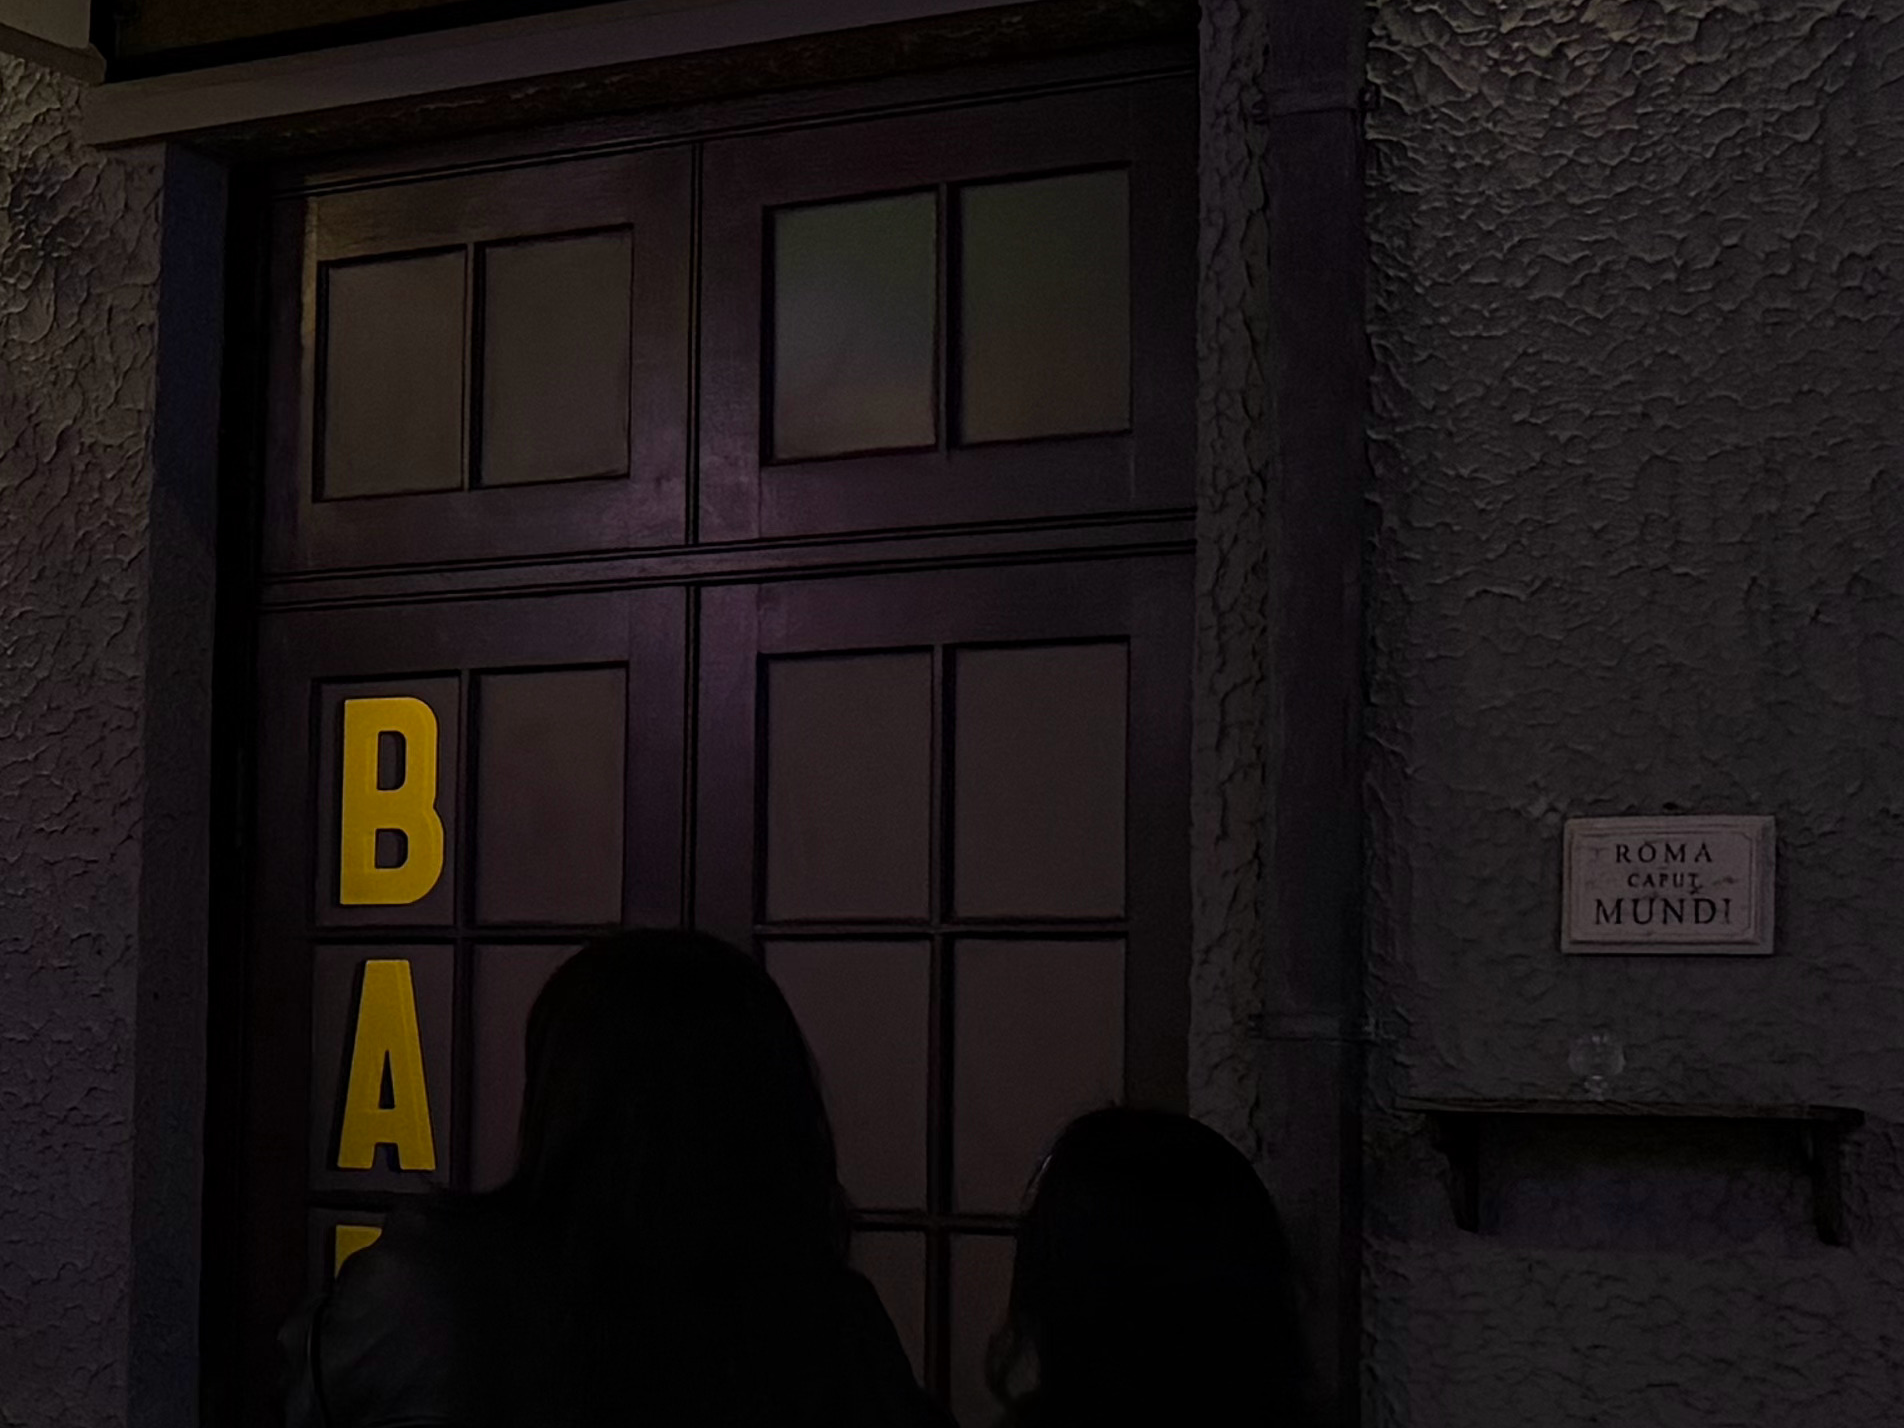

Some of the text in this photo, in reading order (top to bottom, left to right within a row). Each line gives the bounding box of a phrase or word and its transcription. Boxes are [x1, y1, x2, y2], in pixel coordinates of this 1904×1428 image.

[1616, 842, 1712, 864] ROMA
[1628, 873, 1701, 890] CAPUT
[1595, 898, 1733, 925] MUNDI
[336, 694, 446, 1280] BA
